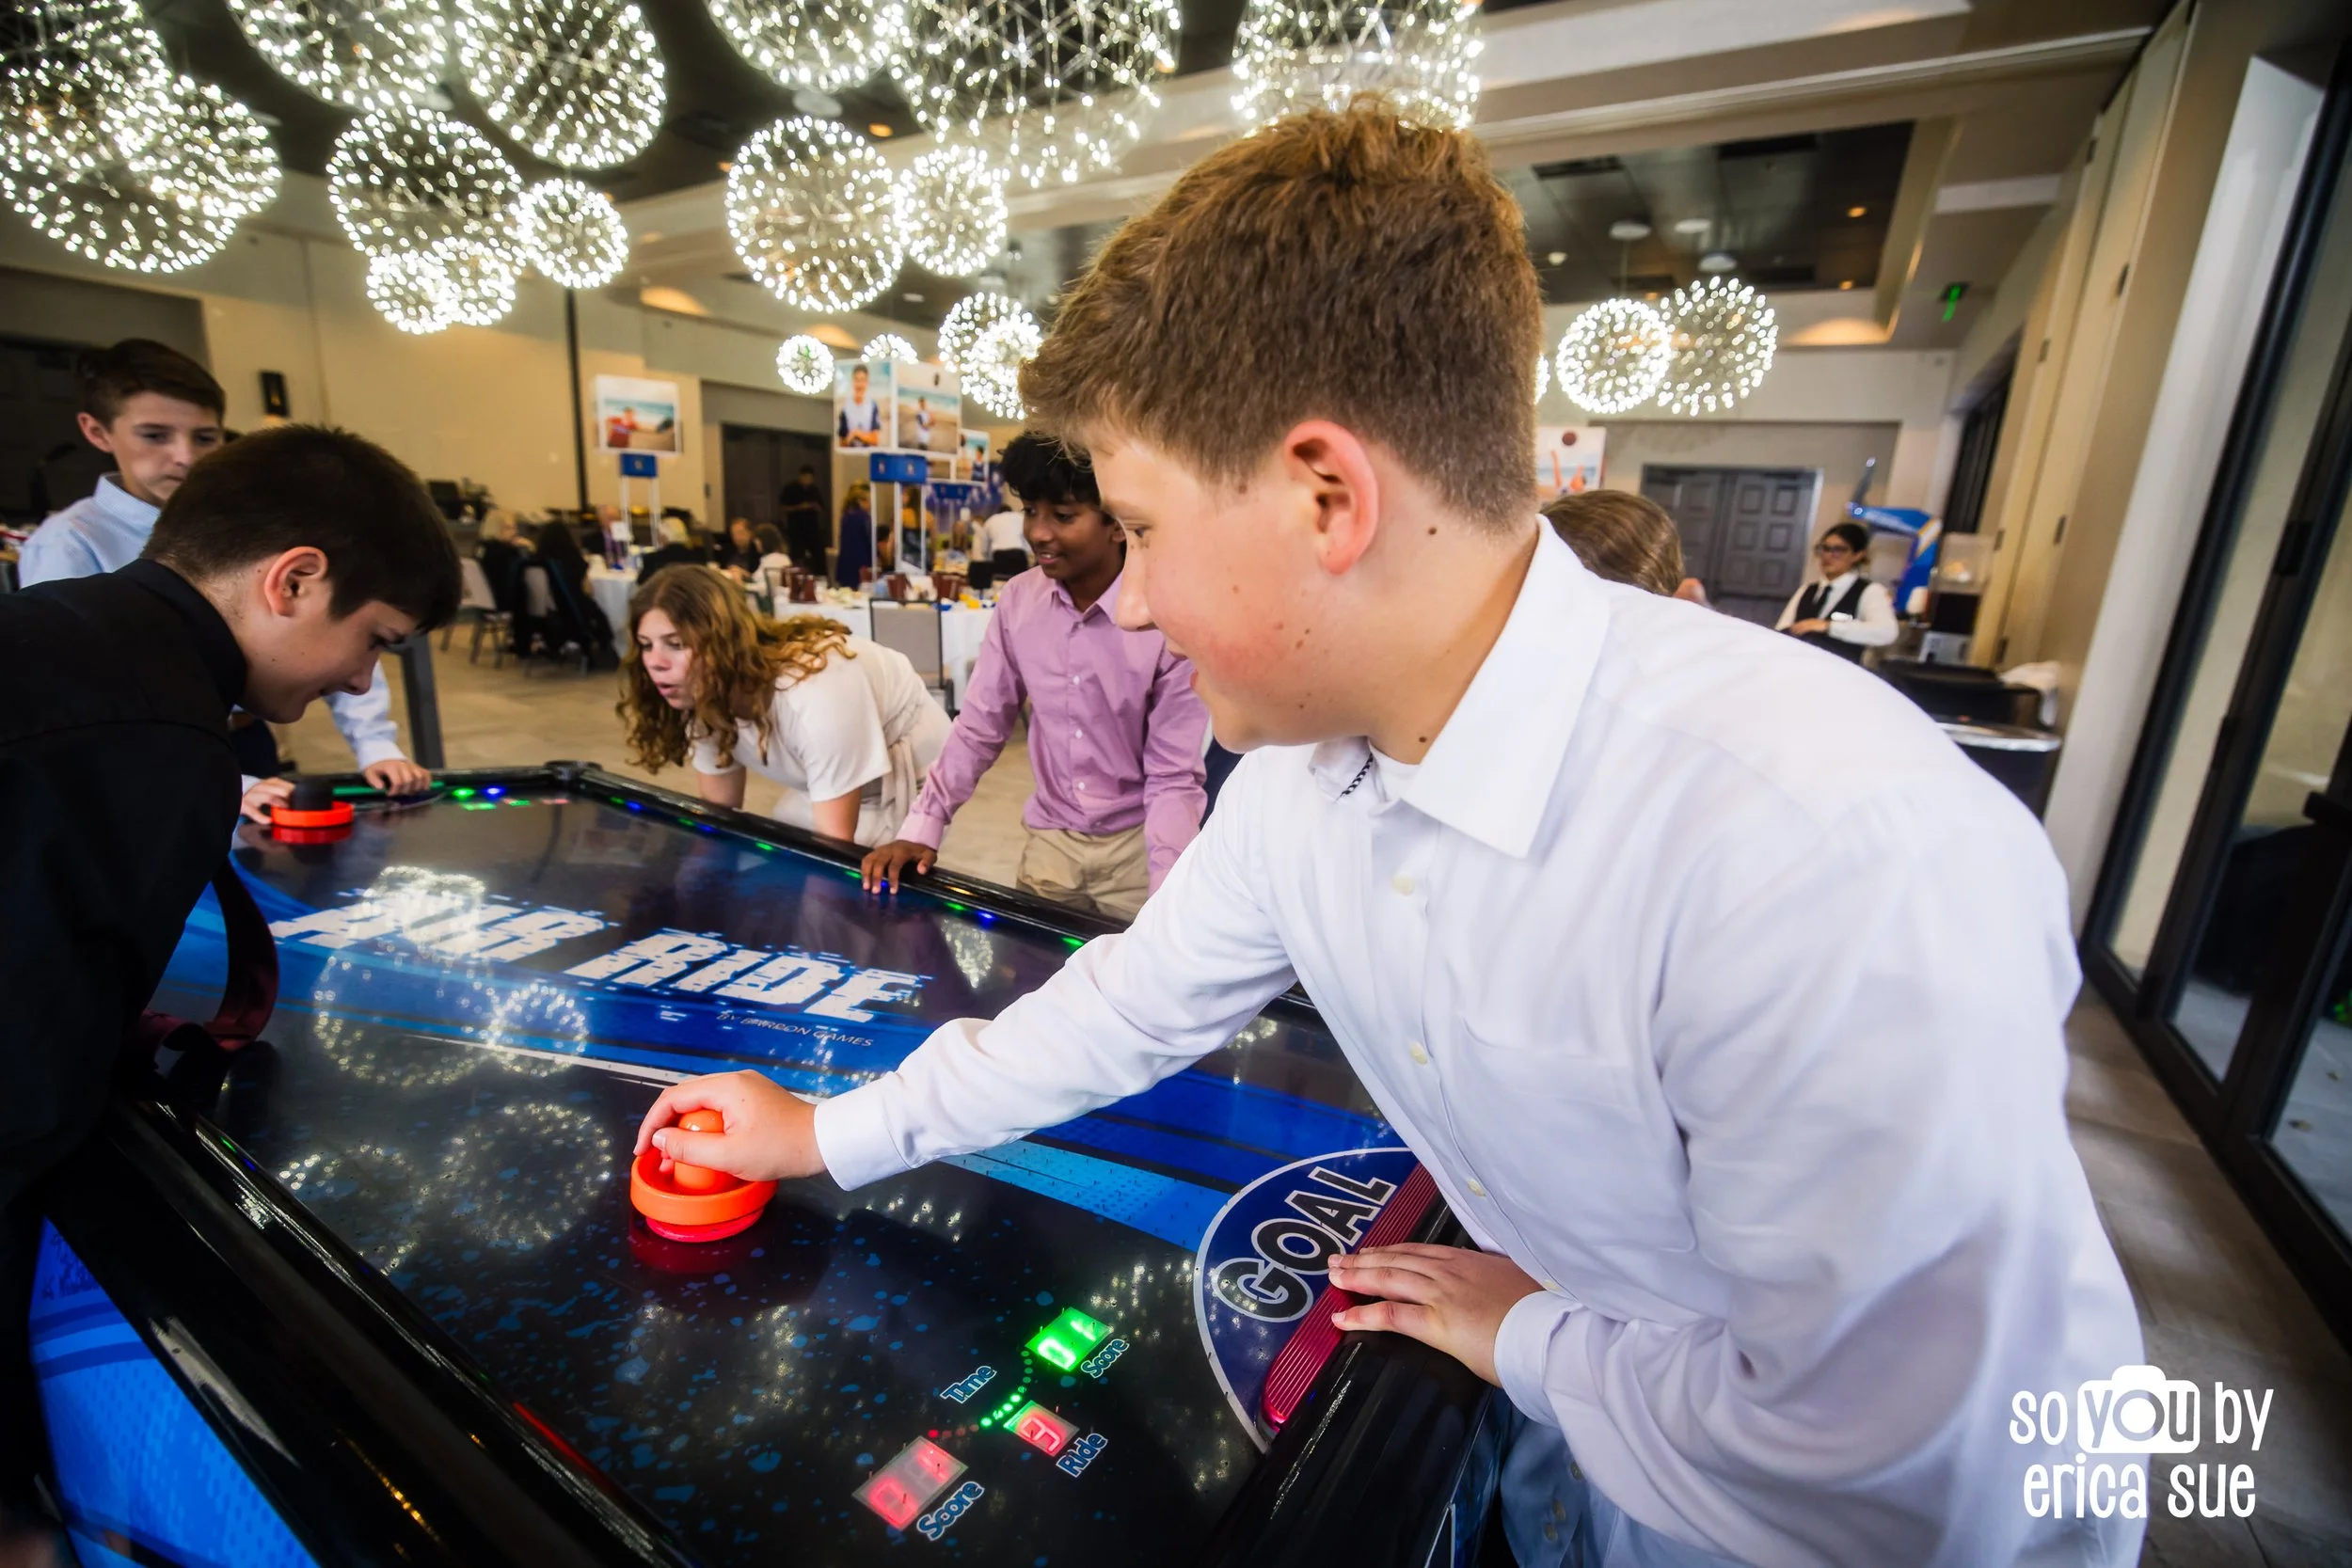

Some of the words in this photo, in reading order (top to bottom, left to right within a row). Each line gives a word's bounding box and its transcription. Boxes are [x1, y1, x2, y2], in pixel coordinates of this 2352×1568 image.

[563, 929, 926, 1023] RIDE
[813, 1031, 874, 1047] GAMES
[1210, 1165, 1398, 1323] GOAL
[1081, 1338, 1129, 1378] Score
[940, 1365, 997, 1403] Time
[1056, 1433, 1108, 1478] Ride
[916, 1481, 985, 1542] Score
